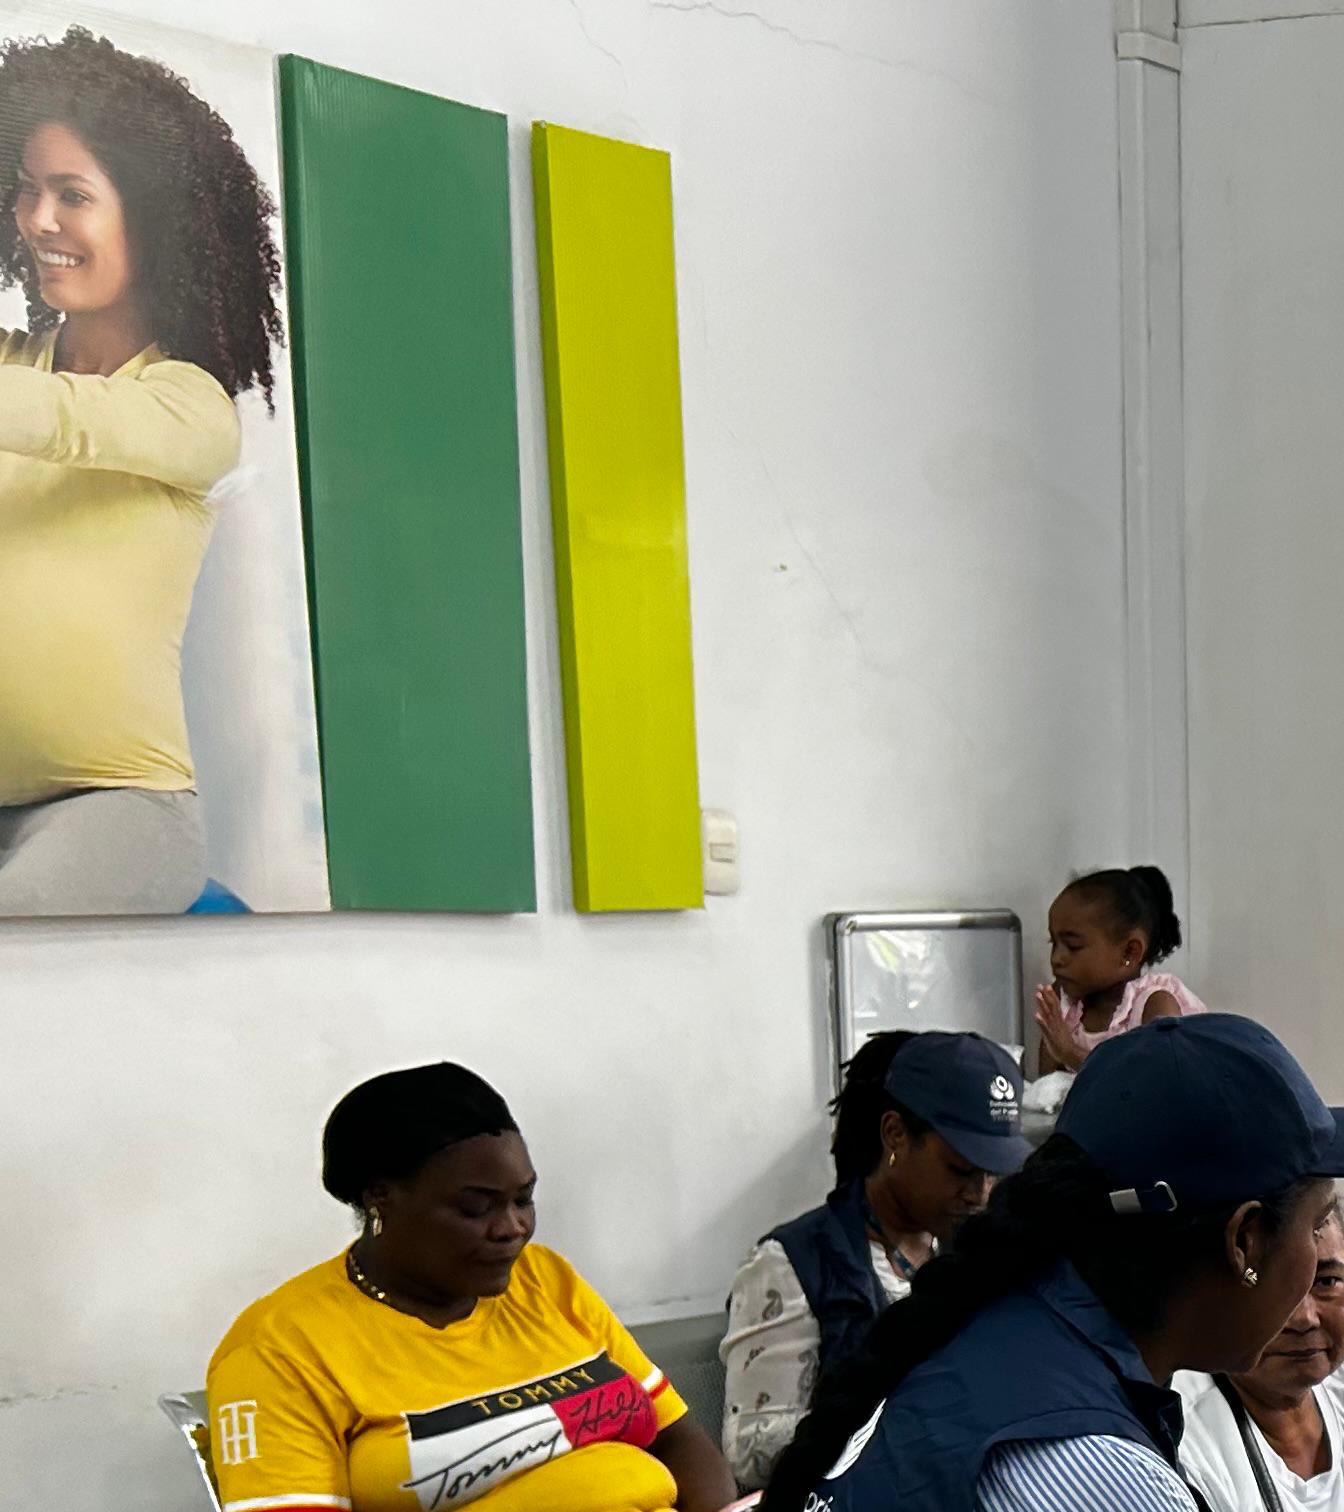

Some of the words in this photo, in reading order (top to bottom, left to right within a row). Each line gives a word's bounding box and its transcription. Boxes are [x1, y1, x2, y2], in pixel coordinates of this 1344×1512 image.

[457, 518, 482, 538] RUTA
[484, 522, 496, 541] DE
[498, 525, 553, 551] EVACUACIÓN
[472, 1367, 596, 1416] TOMMY
[401, 1417, 563, 1511] Tommy
